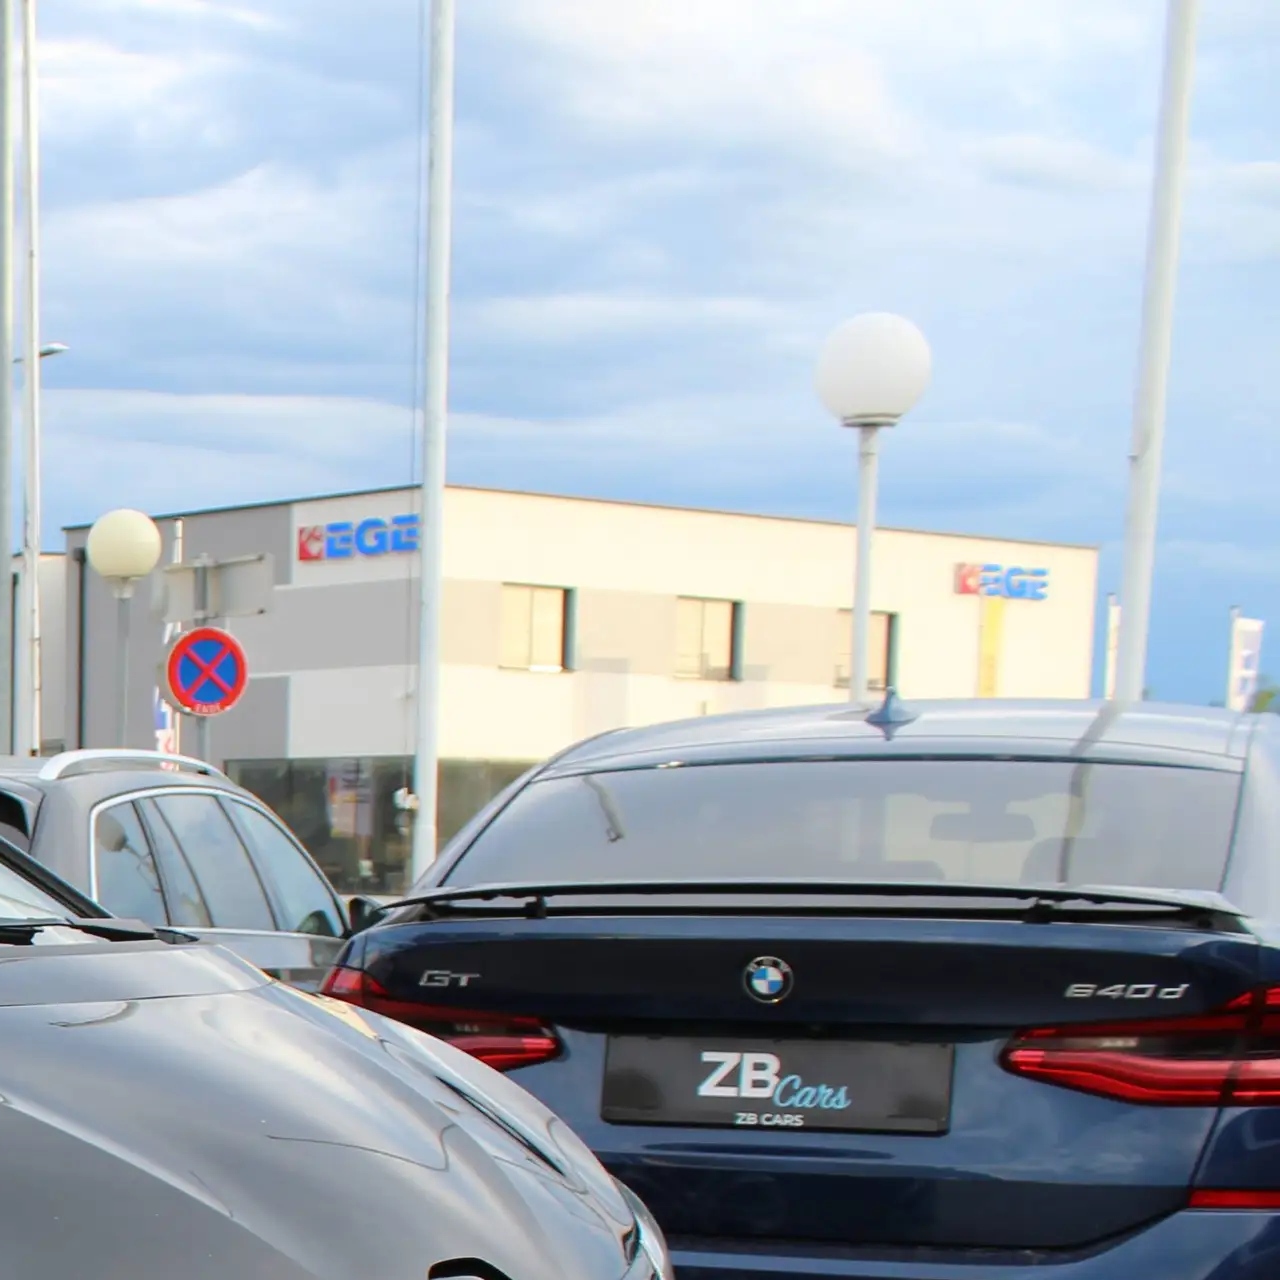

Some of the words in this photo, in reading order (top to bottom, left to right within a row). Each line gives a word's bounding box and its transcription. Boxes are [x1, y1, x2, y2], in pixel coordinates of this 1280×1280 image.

[419, 970, 480, 986] GT
[1064, 983, 1190, 999] 640d
[697, 1051, 781, 1098] ZB
[773, 1074, 851, 1109] Cars
[735, 1112, 758, 1125] ZB
[760, 1113, 805, 1127] CARS
